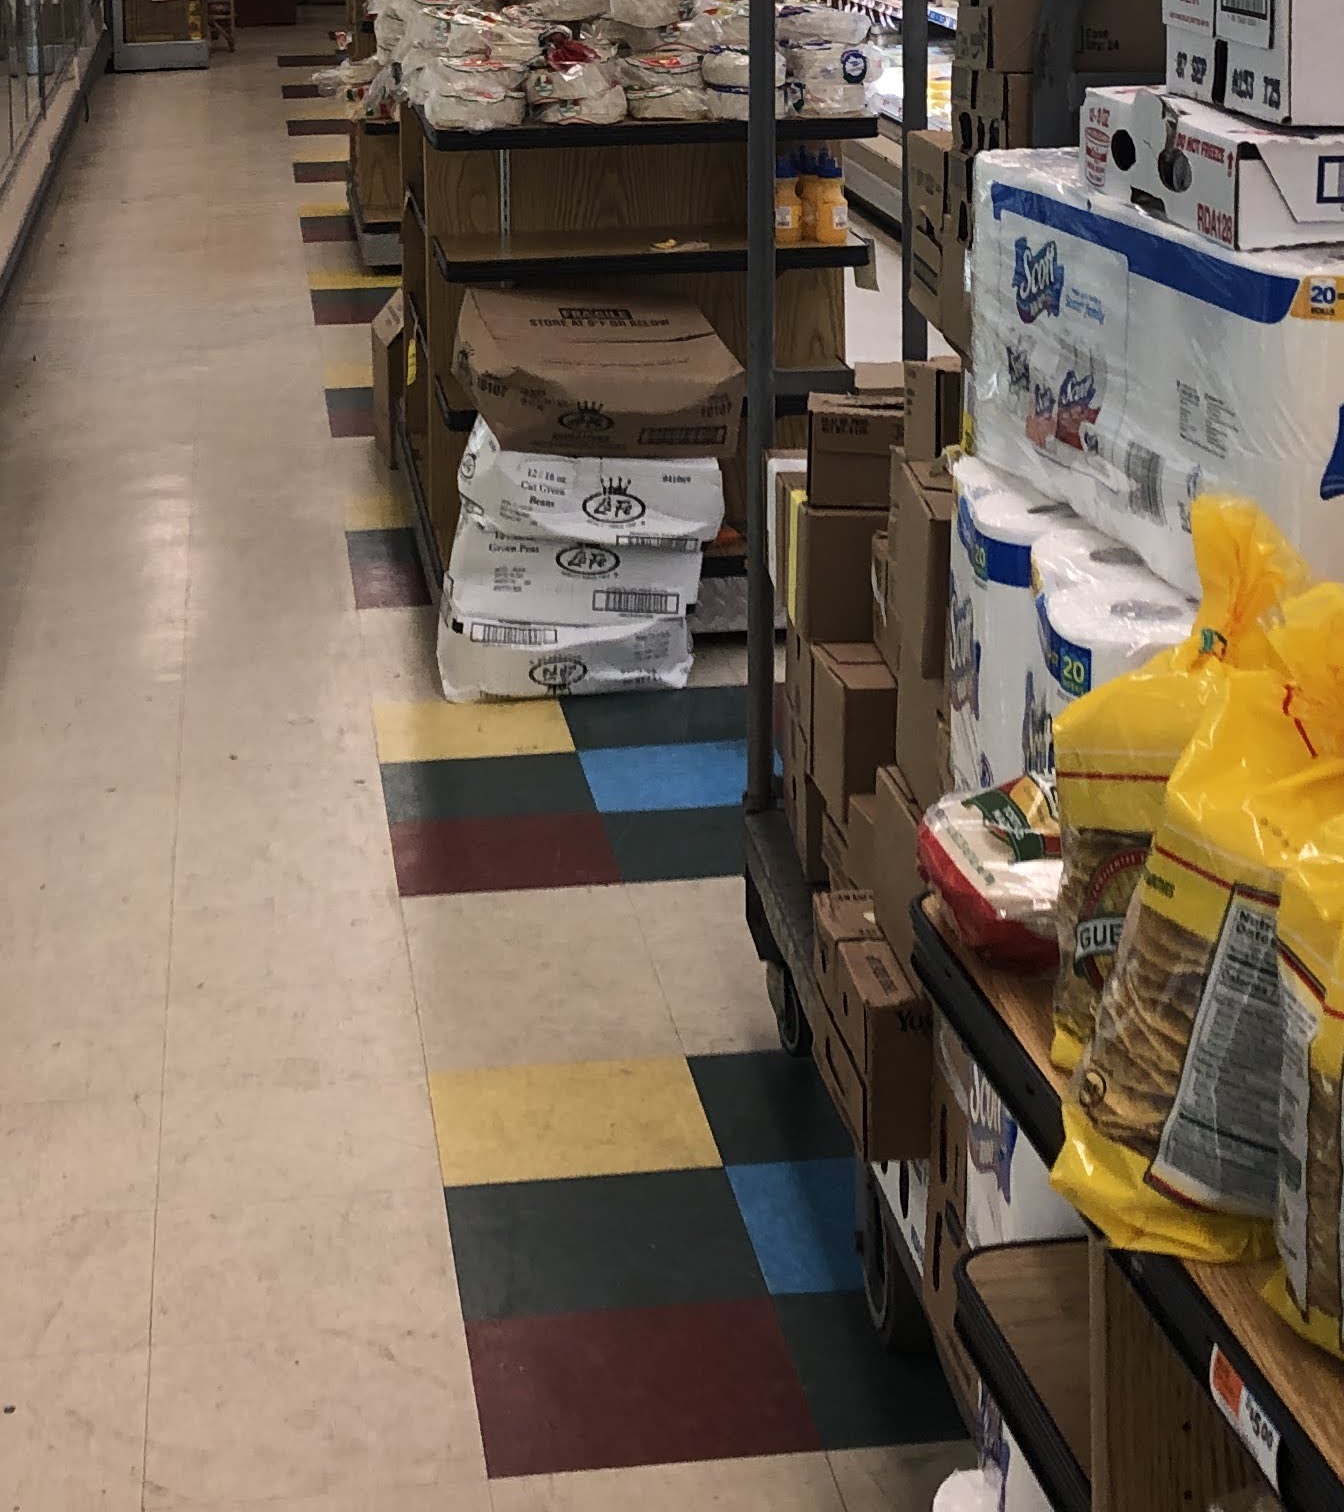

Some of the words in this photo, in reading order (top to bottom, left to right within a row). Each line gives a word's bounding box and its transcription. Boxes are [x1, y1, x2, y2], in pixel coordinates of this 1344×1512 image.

[1186, 134, 1200, 152] NOT
[1200, 139, 1226, 165] FREEZE
[1197, 201, 1233, 245] RDA128
[1018, 241, 1056, 300] Scott
[1310, 306, 1336, 317] ROLLS
[529, 318, 566, 328] STORE
[609, 318, 628, 328] OR
[630, 318, 670, 328] BELOW
[520, 480, 538, 491] Cut
[538, 483, 567, 496] Green
[529, 494, 555, 509] Beans
[594, 497, 613, 516] La
[614, 498, 633, 518] Fe
[488, 543, 518, 554] Green
[518, 543, 540, 554] Peas
[974, 546, 987, 566] 20
[567, 550, 587, 568] La
[588, 551, 608, 570] Fe
[1062, 656, 1086, 684] 20
